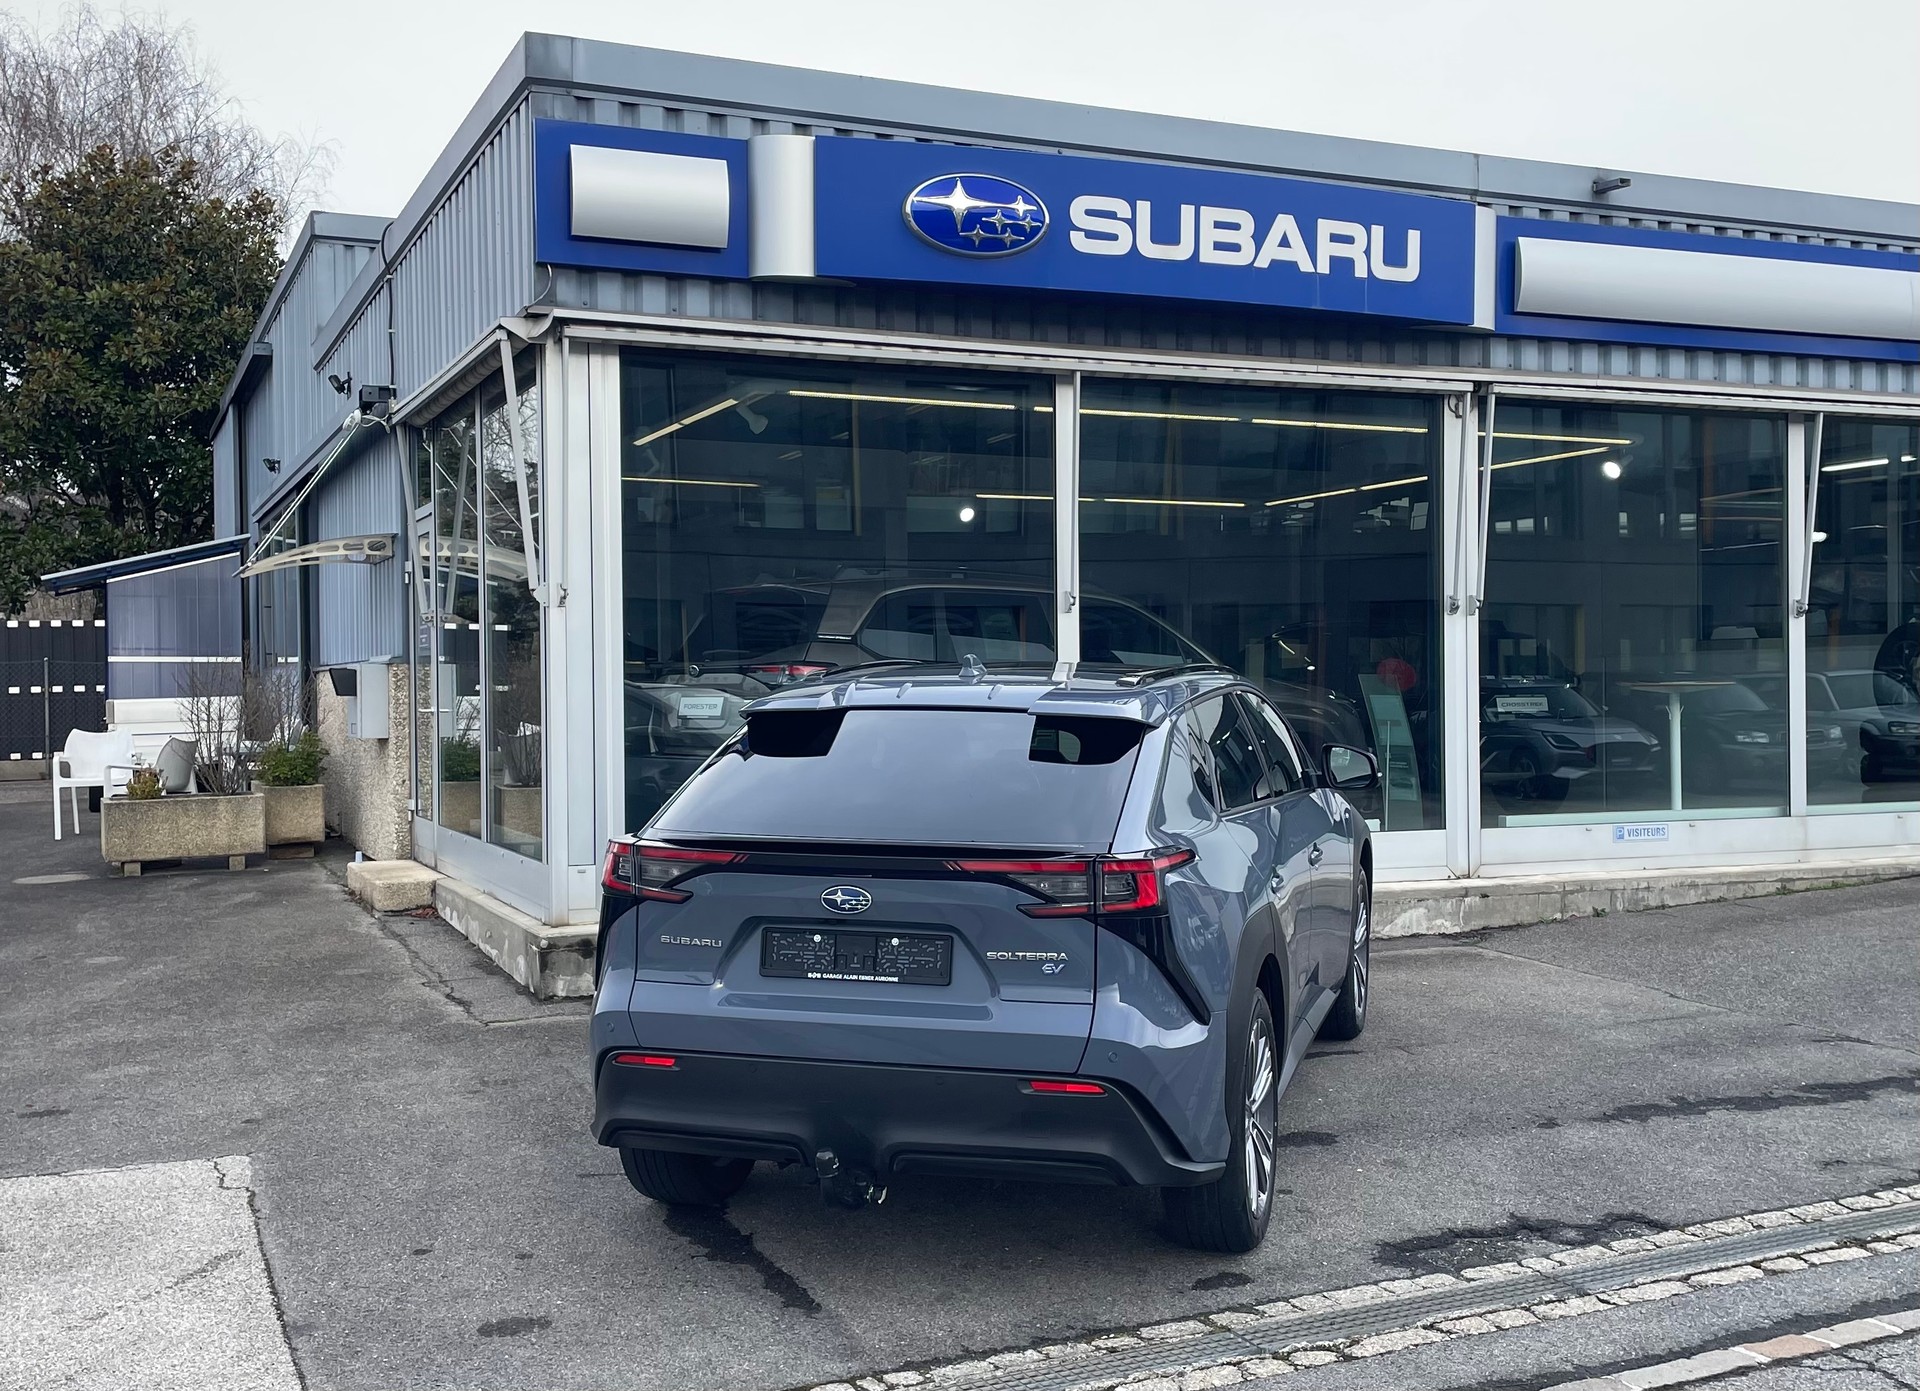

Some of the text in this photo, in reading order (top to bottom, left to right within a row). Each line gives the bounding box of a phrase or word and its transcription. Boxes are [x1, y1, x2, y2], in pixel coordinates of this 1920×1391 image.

[1069, 195, 1421, 283] SUBARU
[1627, 827, 1666, 838] VISITEURS
[660, 935, 722, 947] SUBARU
[986, 952, 1069, 961] SOLTERRA
[1041, 963, 1066, 974] EV
